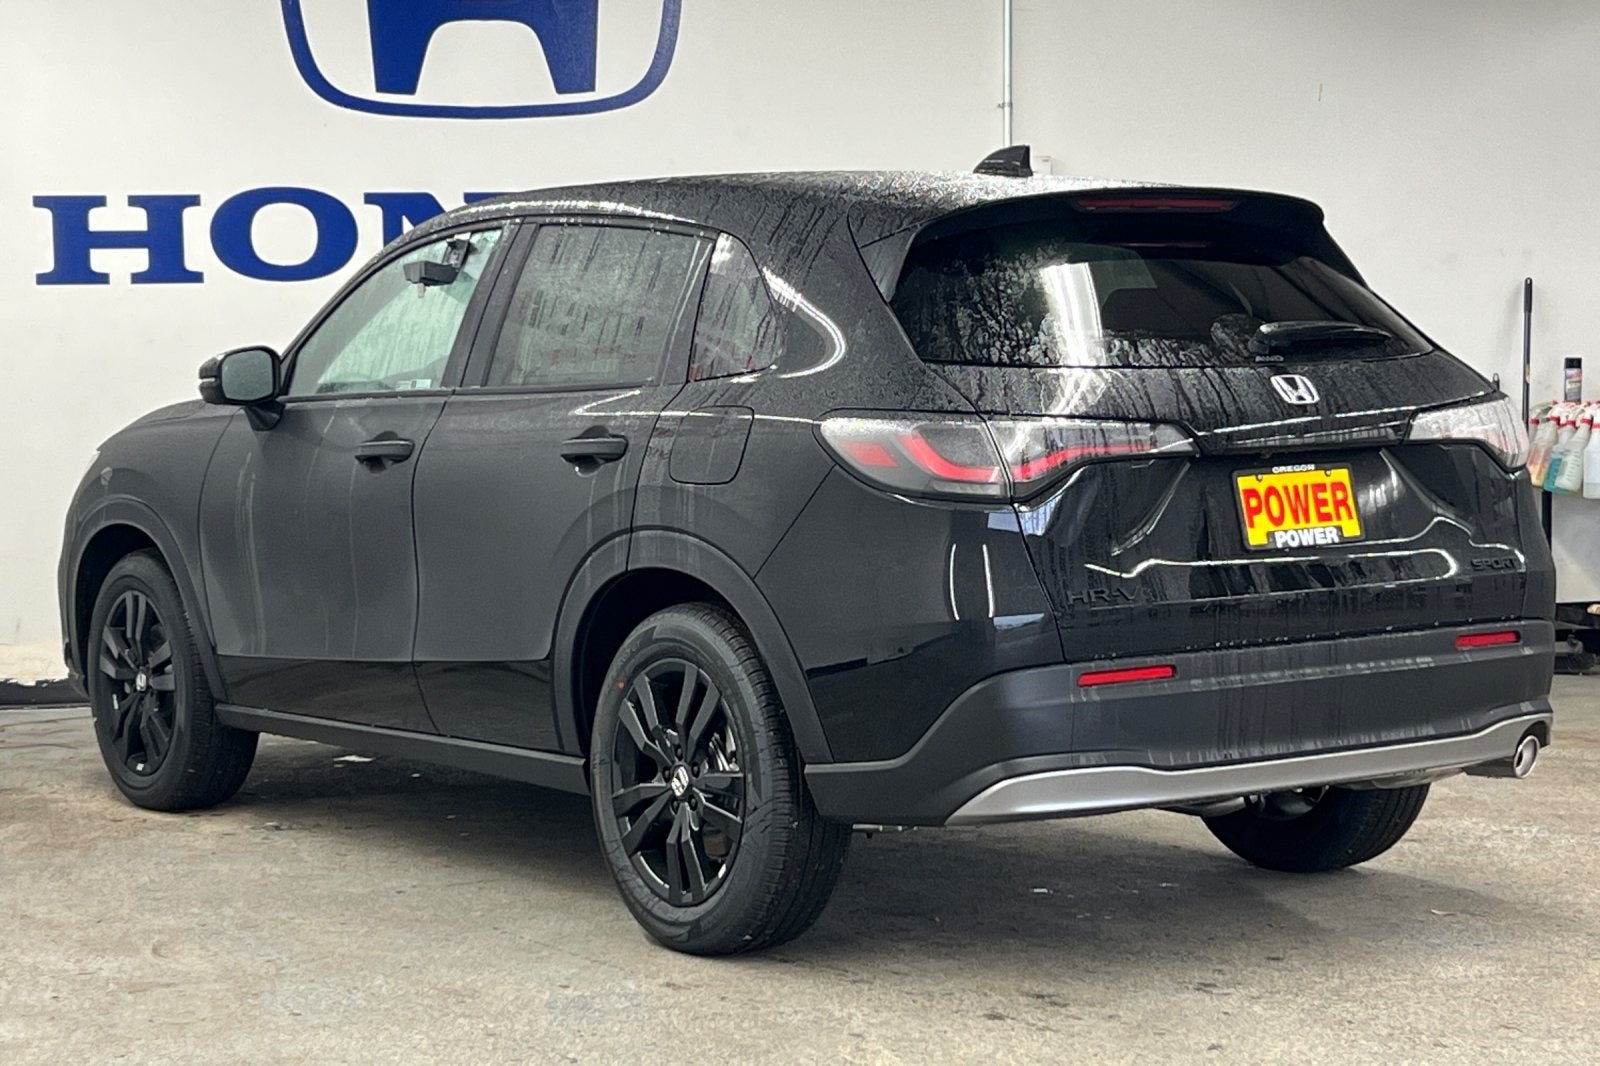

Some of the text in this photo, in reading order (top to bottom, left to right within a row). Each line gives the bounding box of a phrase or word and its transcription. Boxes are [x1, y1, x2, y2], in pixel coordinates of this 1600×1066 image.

[1272, 464, 1315, 473] OREGON
[1242, 481, 1353, 528] POWER
[1274, 526, 1339, 548] POWER
